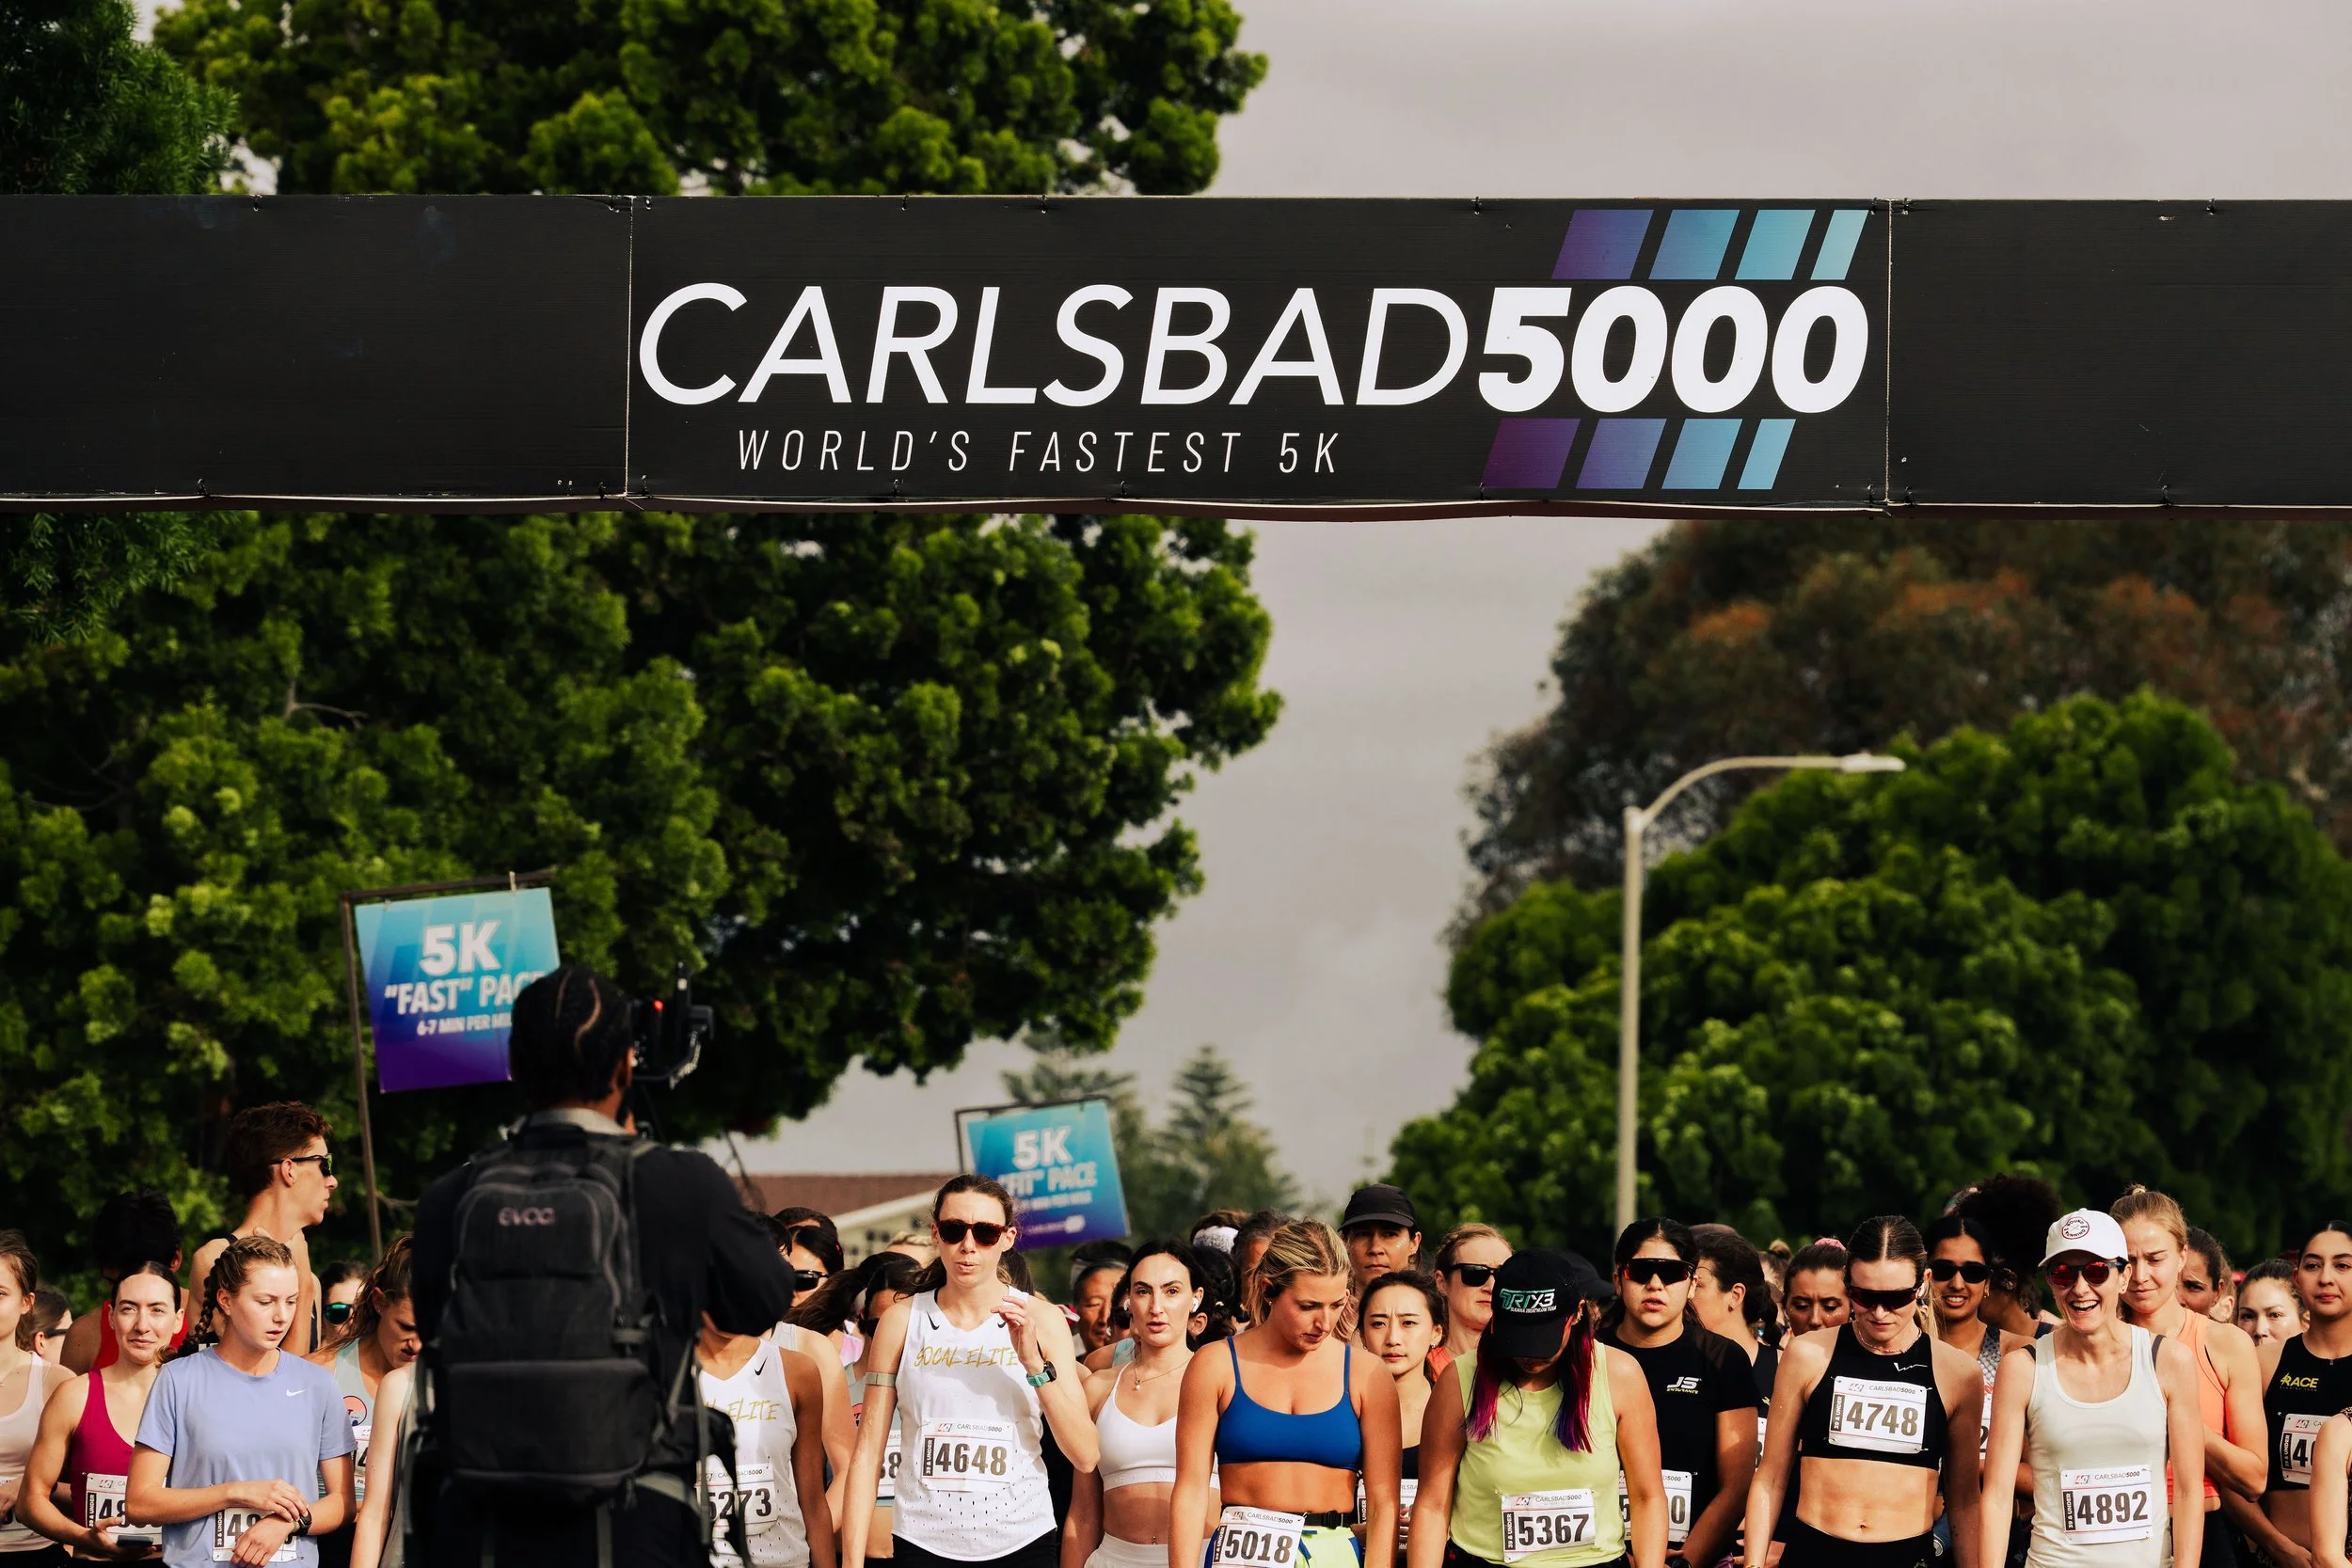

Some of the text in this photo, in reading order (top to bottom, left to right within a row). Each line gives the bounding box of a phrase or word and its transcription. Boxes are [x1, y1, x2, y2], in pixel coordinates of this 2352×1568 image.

[739, 430, 1340, 475] WORLD'S FASTEST 5K
[420, 920, 501, 975] 5K
[384, 976, 474, 1015] "FAST"
[1012, 1125, 1073, 1170] 5K
[1047, 1161, 1098, 1192] PACE
[914, 1345, 1018, 1369] SOCAL ELITE
[1666, 1376, 1700, 1389] JS
[2280, 1372, 2319, 1388] RACE
[726, 1397, 782, 1422] ELITE
[1846, 1401, 1919, 1436] 4748
[935, 1442, 1008, 1476] 4648
[2077, 1490, 2149, 1525] 4892
[1216, 1527, 1226, 1547] UNDER
[1224, 1529, 1294, 1563] 5018
[1518, 1513, 1590, 1545] 5367
